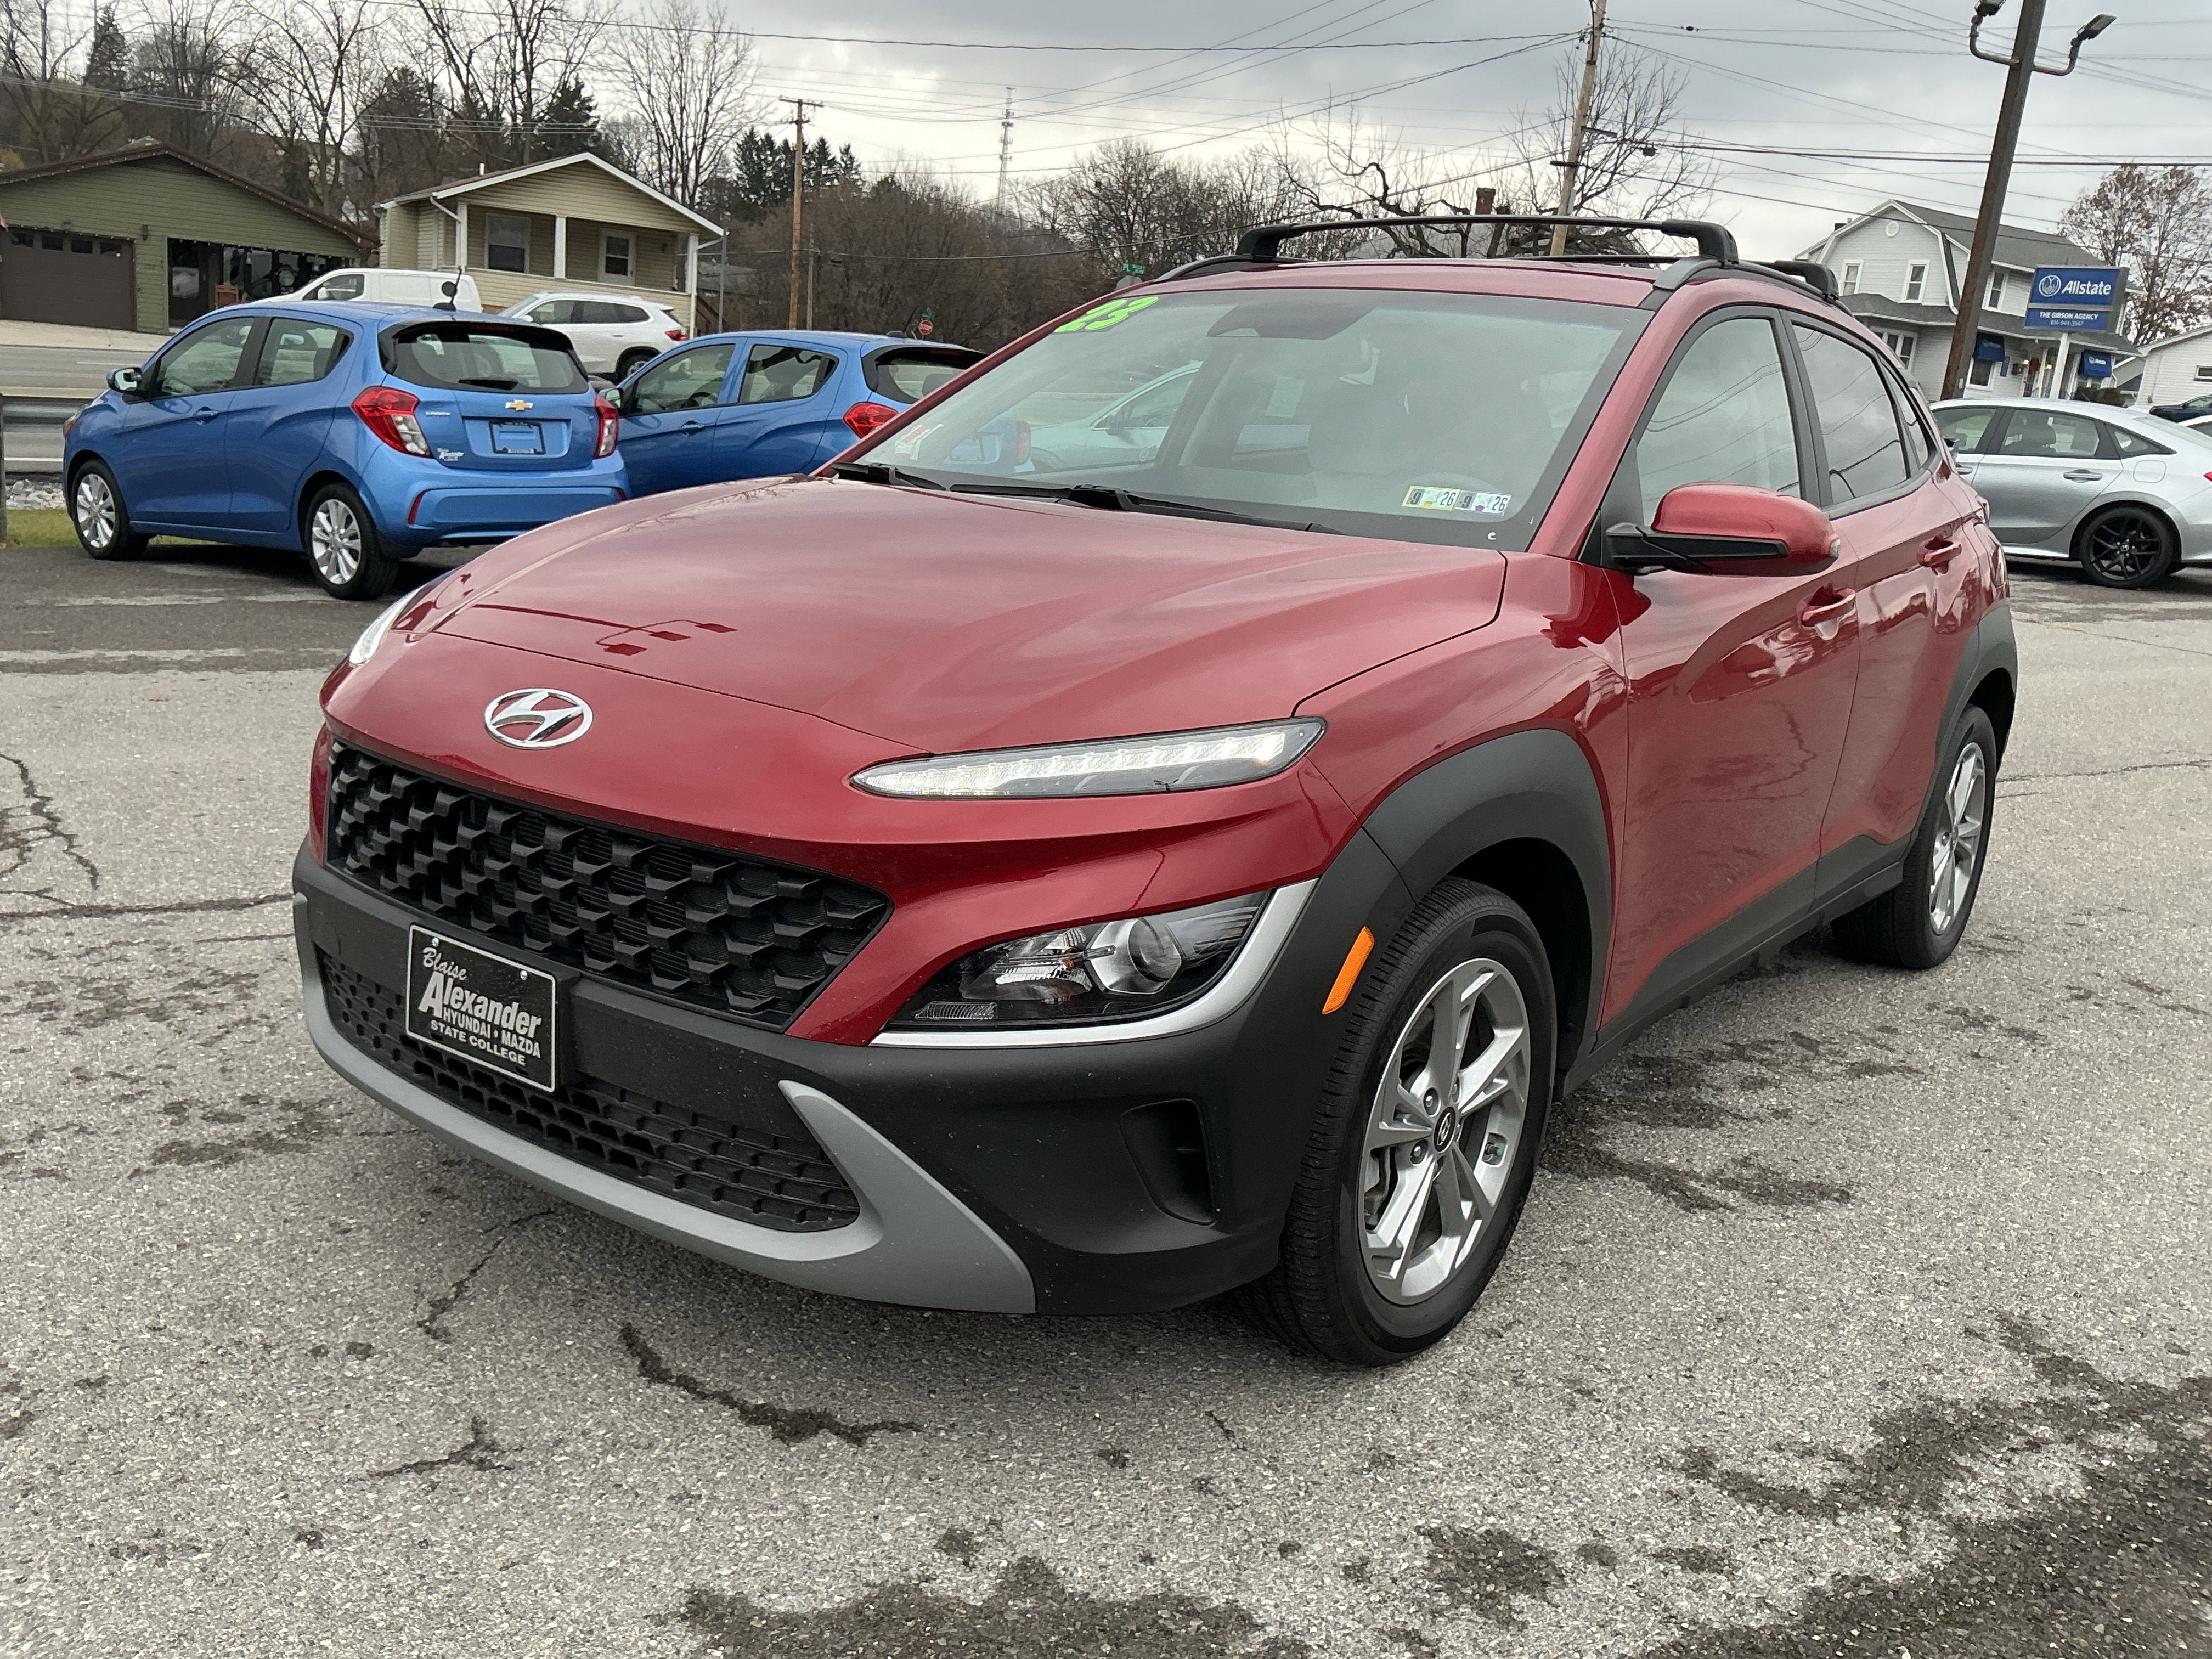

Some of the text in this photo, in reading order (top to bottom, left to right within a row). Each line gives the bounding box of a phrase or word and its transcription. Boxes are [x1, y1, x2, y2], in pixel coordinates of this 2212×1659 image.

[2062, 280, 2112, 295] Allstate
[1054, 295, 1159, 333] 23
[1440, 492, 1456, 506] 26
[1492, 496, 1508, 511] 26
[422, 947, 467, 980] Blaise
[418, 971, 542, 1038] Alexander
[431, 1019, 526, 1066] STATE COLLEGE
[443, 1008, 541, 1058] HYUNDAI MAZDA
